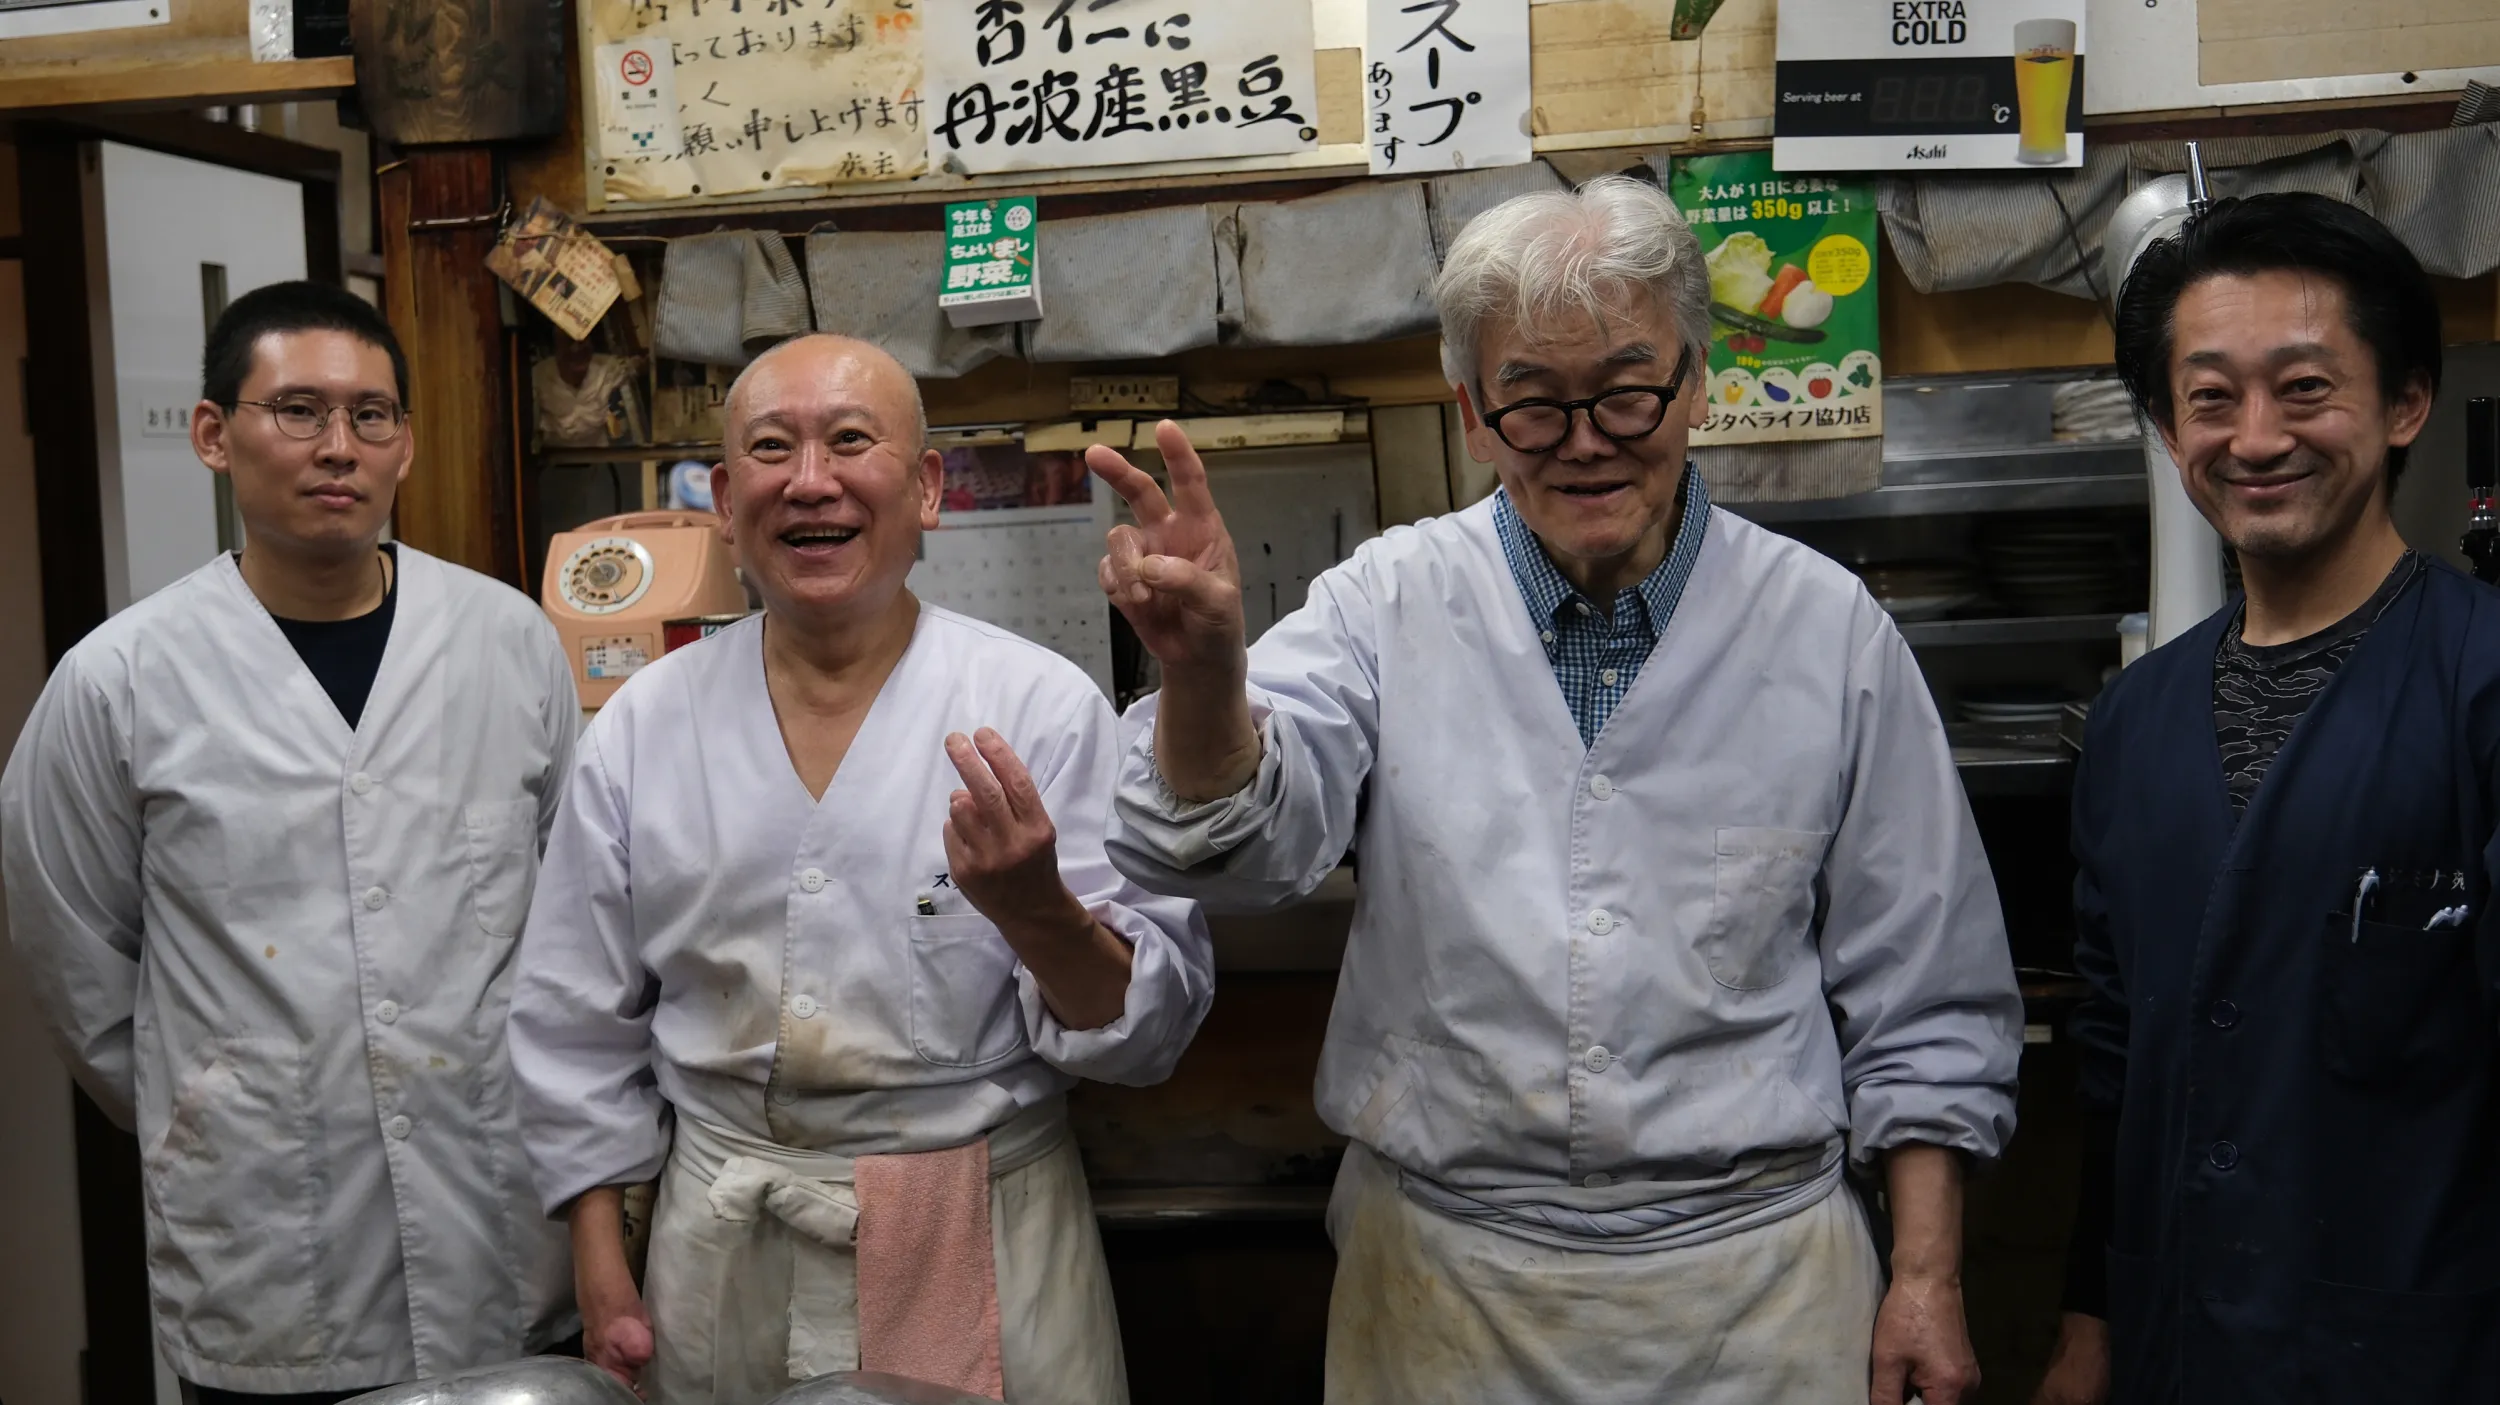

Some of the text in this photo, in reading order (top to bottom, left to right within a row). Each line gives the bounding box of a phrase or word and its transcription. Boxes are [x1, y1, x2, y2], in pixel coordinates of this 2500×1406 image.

[1892, 1, 1966, 20] EXTRA
[975, 0, 1191, 67] 杏仁に
[1892, 20, 1966, 46] COLD
[1396, 0, 1482, 147] スープ
[933, 54, 1318, 149] 丹波産黒豆。
[1783, 91, 1863, 104] Serving beer at
[1367, 61, 1406, 170] あります
[1906, 144, 1947, 160] Asahi
[951, 208, 993, 225] 今年も
[951, 222, 993, 239] 足立は
[1702, 405, 1872, 432] ジタベライフ協力店
